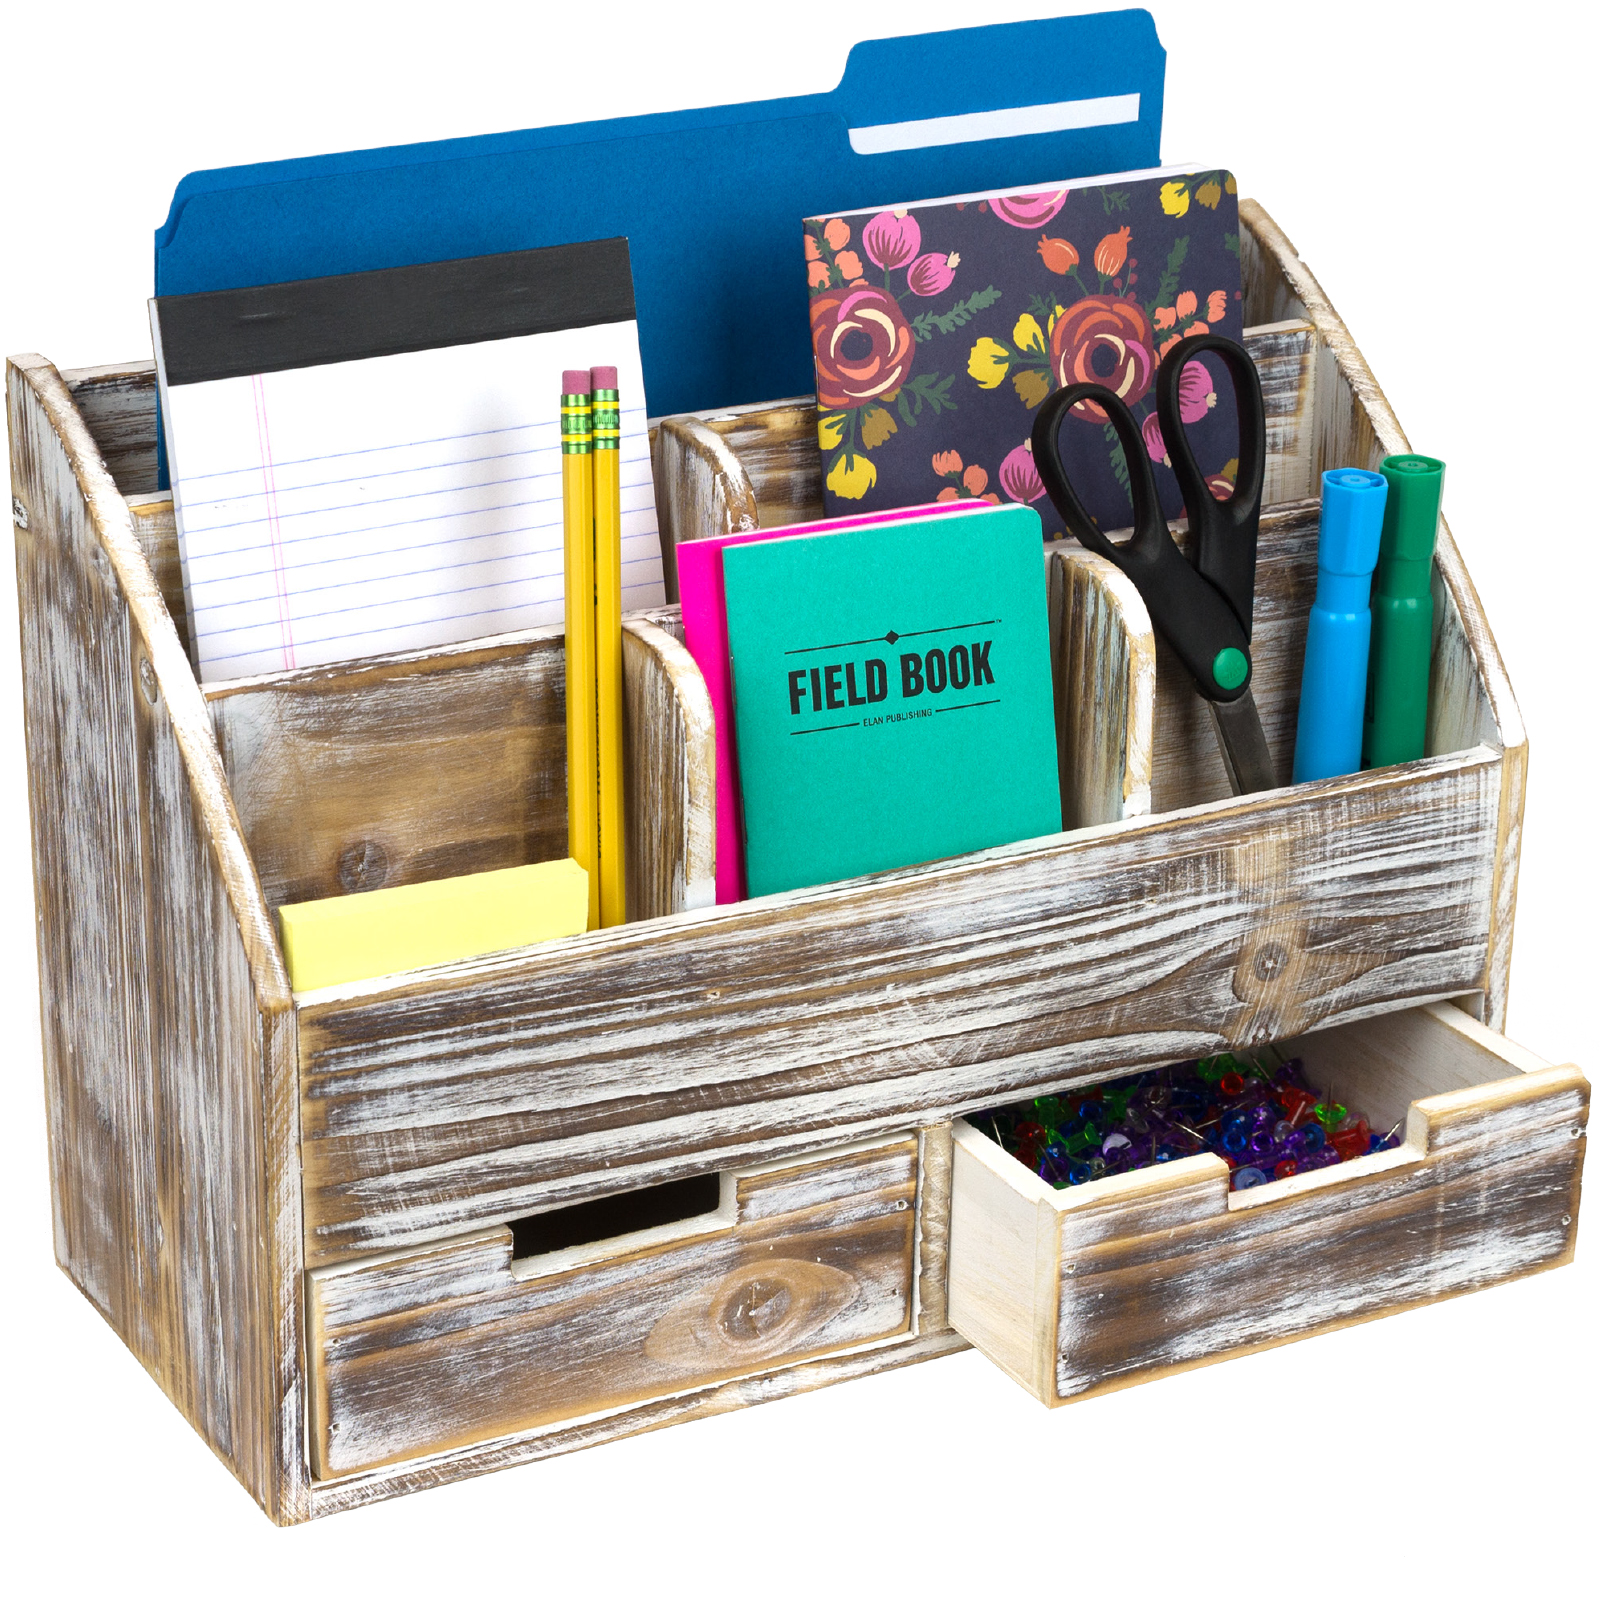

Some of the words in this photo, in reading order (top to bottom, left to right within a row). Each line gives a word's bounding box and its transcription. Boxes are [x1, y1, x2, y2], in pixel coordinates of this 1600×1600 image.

[788, 658, 888, 715] FIELD
[900, 640, 996, 698] BOOK
[863, 716, 884, 727] ELAN
[886, 708, 933, 723] PUBLISHING
